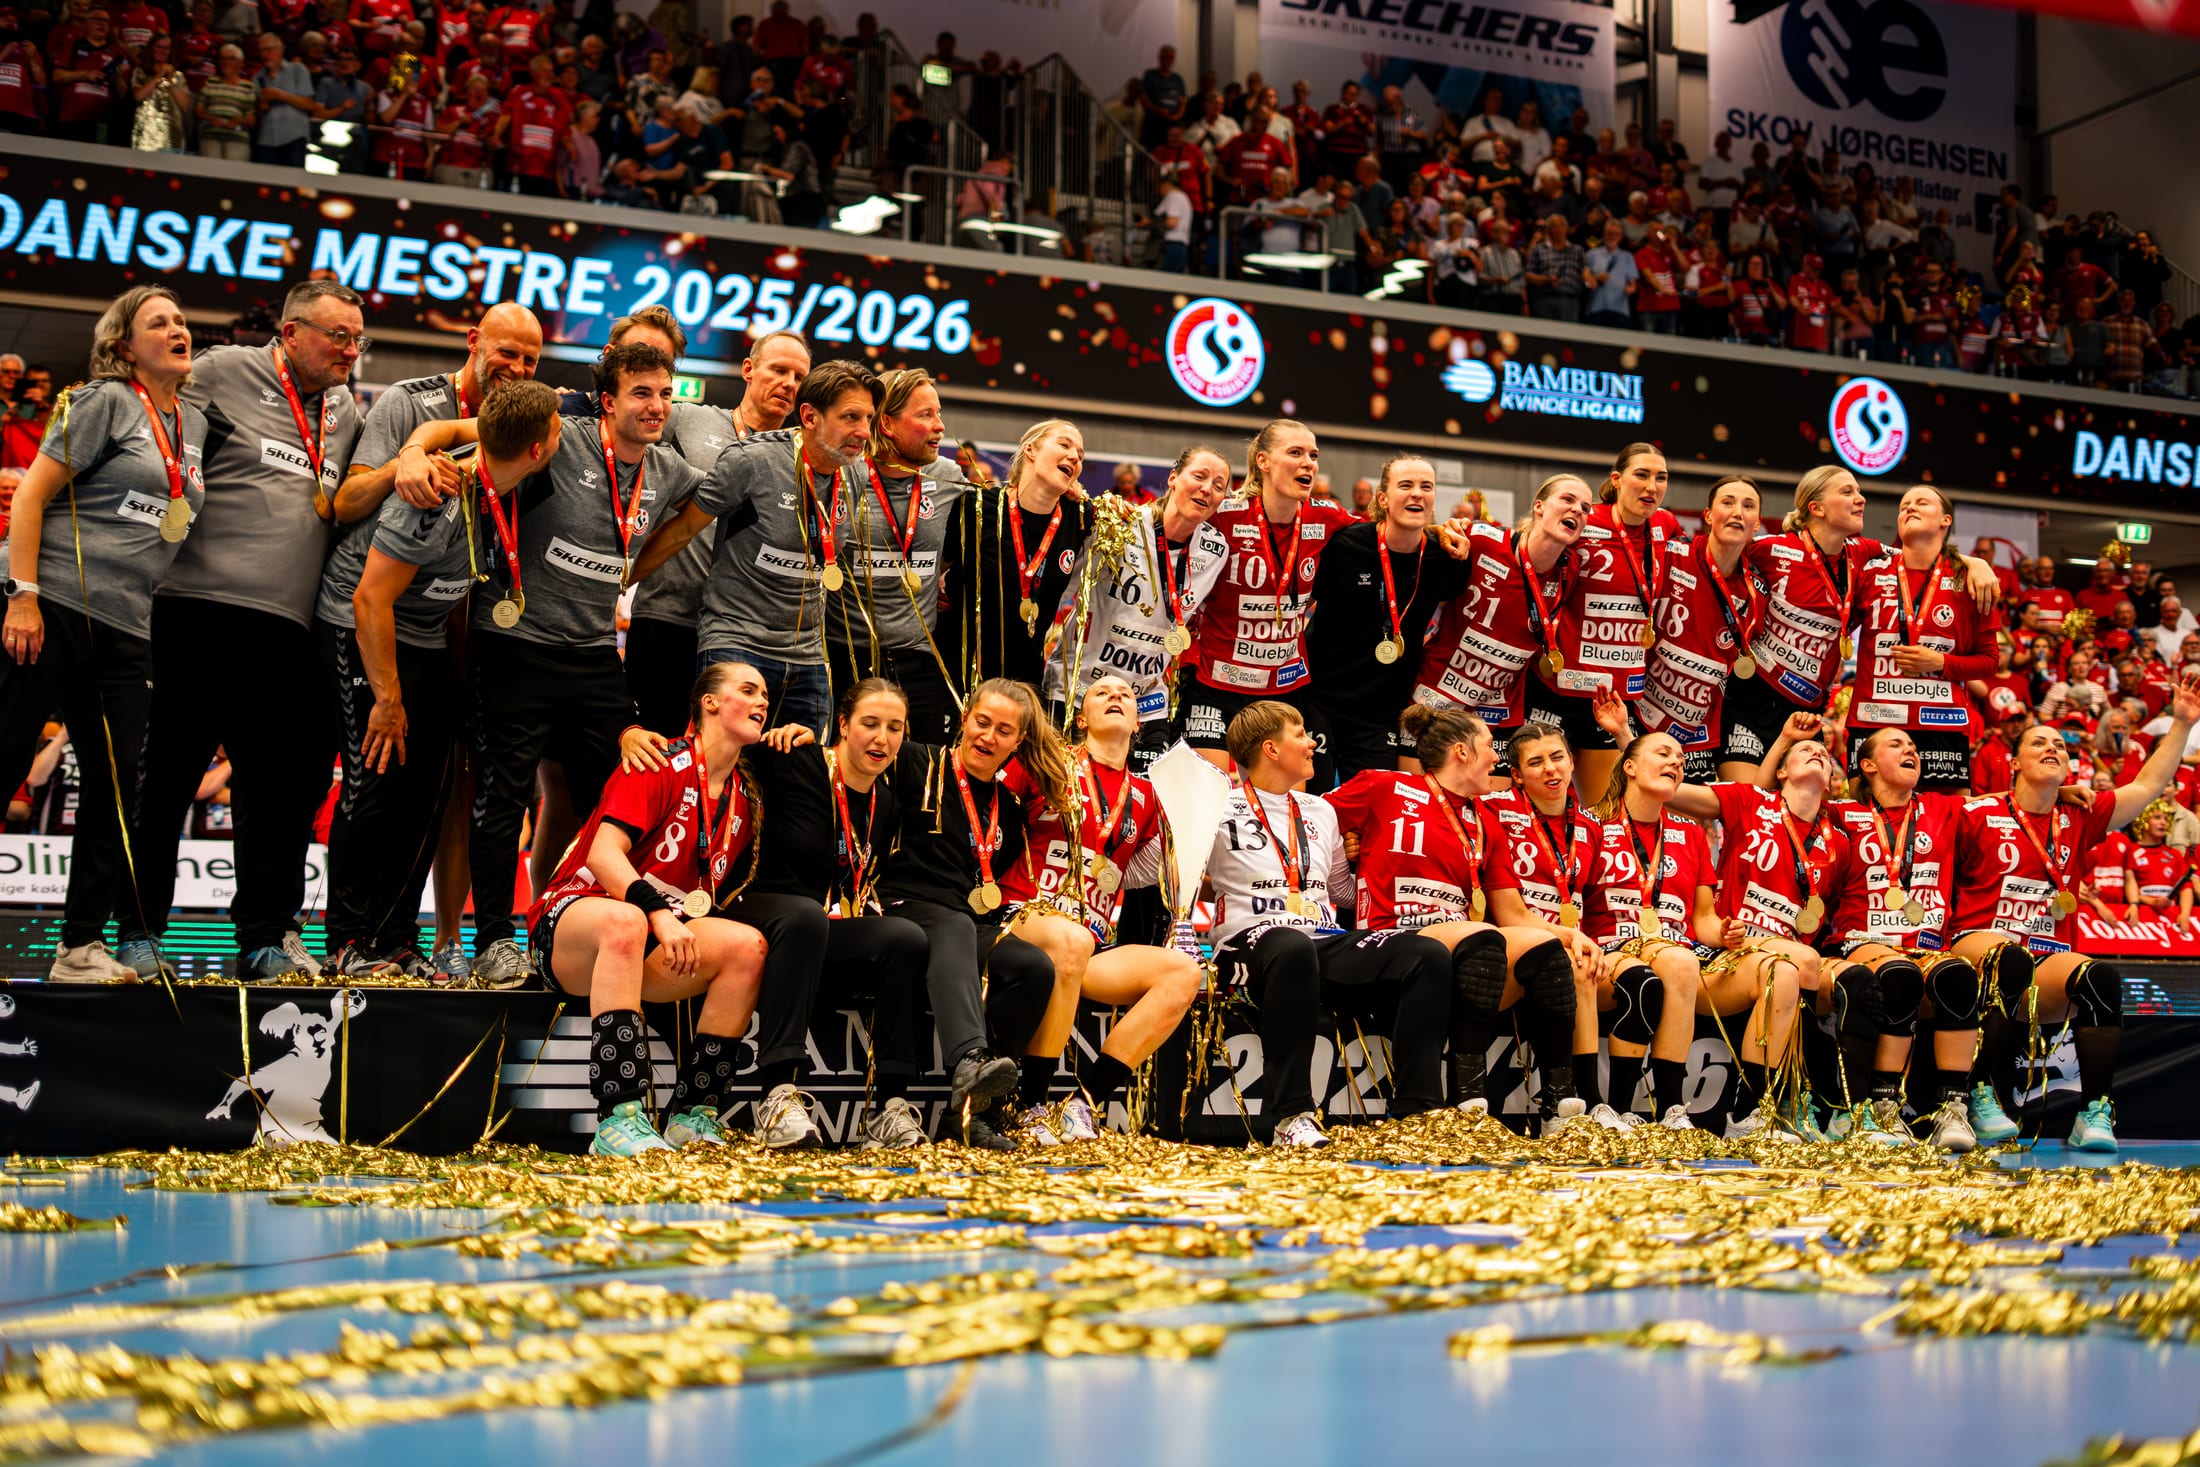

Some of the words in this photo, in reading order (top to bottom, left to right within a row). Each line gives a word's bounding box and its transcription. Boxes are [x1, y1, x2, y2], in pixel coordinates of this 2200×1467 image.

[1282, 0, 1599, 56] ECHERS
[1727, 108, 1813, 146] SKOV
[1821, 124, 2008, 181] JØRGENSEN
[311, 228, 613, 315] MESTRE
[630, 264, 971, 355] 2025/2026
[1502, 360, 1644, 400] BAMBUNI
[1500, 391, 1645, 424] KVINDELIGAEN
[264, 446, 338, 481] SKECHRS
[2072, 430, 2200, 488] DANS
[124, 499, 168, 519] SKEC
[550, 546, 623, 576] SKECHER
[760, 553, 823, 573] SKECHE
[1226, 553, 1267, 589] 10
[1579, 548, 1614, 582] 22
[1107, 566, 1142, 606] 16
[1462, 584, 1501, 630] 21
[1586, 601, 1644, 613] SKECHE
[1770, 600, 1841, 634] SKECHERS
[1869, 598, 1899, 630] 17
[1110, 624, 1165, 646] SKECHE
[1656, 646, 1729, 681] SKECHERS
[1876, 681, 1949, 699] Bluebyte
[1185, 717, 1227, 735] WATER
[1190, 704, 1223, 719] BLUE
[1188, 730, 1221, 739] SHIPPING
[1927, 762, 1955, 771] HAVN
[1222, 818, 1268, 851] 13
[1387, 817, 1427, 858] 11
[1739, 829, 1780, 872] 20
[1858, 832, 1881, 865] 6
[1597, 850, 1637, 885] 29
[1998, 841, 2020, 875] 9
[1868, 870, 1939, 883] SKHERS
[1398, 884, 1468, 907] SKECHERS
[1609, 895, 1684, 914] SKEERS
[1746, 889, 1798, 918] SKECHE
[1870, 912, 1943, 926] Blueyte
